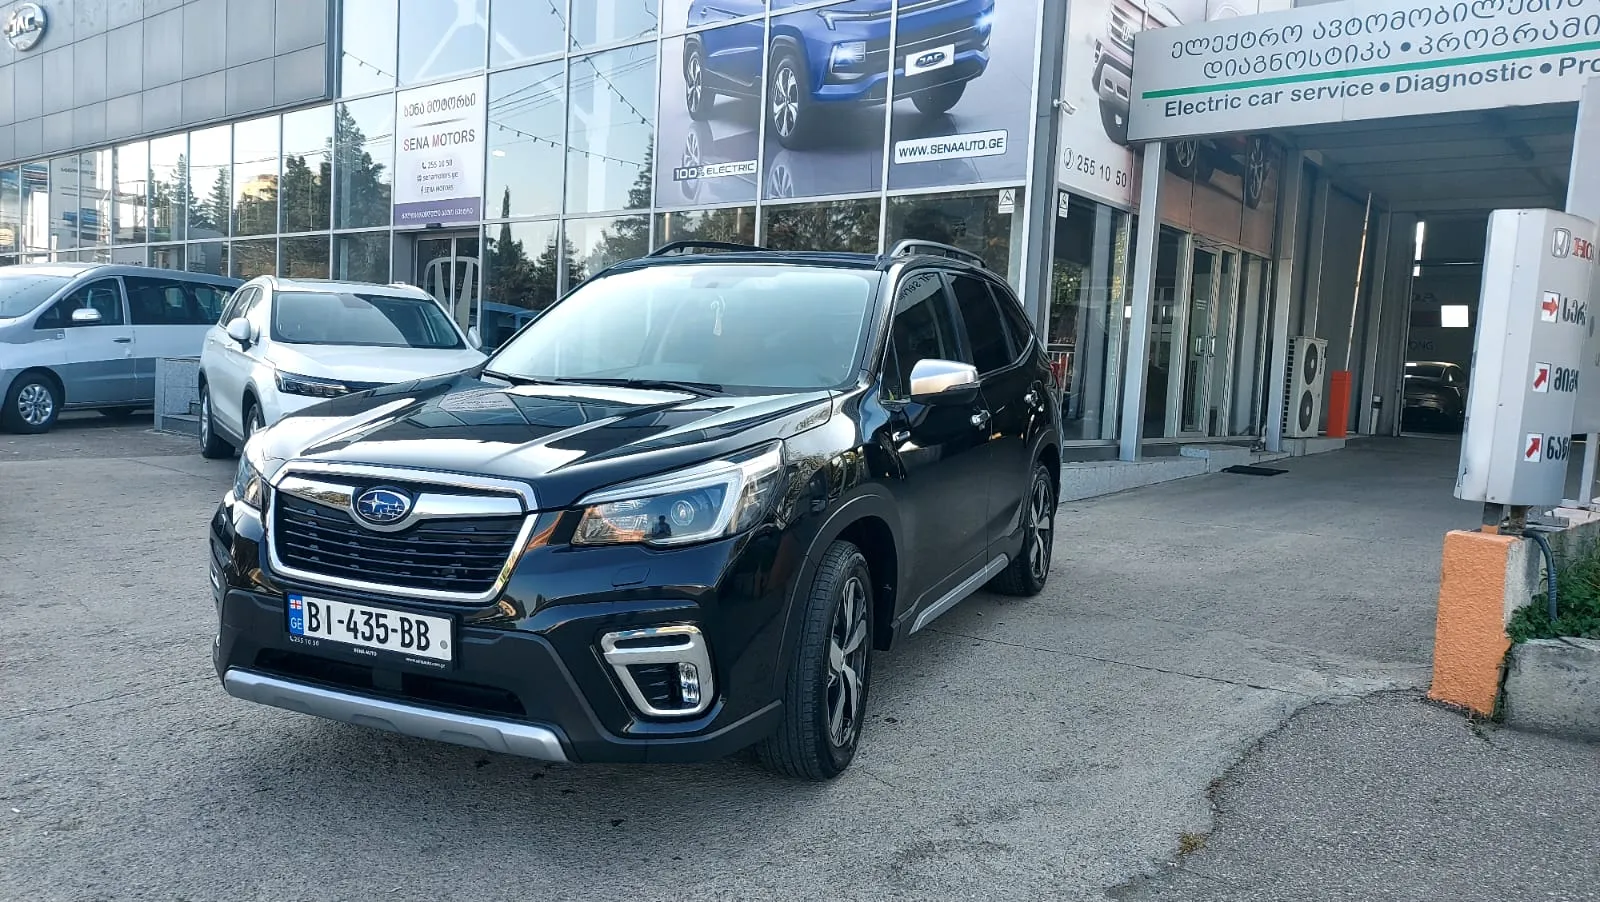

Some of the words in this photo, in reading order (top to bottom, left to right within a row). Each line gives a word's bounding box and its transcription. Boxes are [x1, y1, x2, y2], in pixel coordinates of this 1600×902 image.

[1171, 24, 1303, 59] ელექტრო
[1203, 40, 1391, 79] დიაგნოსტიკა
[1164, 93, 1242, 118] Electric
[1248, 90, 1283, 107] car
[1290, 80, 1374, 102] service
[1395, 62, 1533, 93] Diagnostic
[403, 102, 425, 118] სენა
[426, 92, 476, 114] მოტორსი
[403, 136, 430, 152] SENA
[431, 129, 476, 148] MOTORS
[899, 137, 1004, 158] WWW.SENAAUTO.GE
[706, 162, 755, 175] ELECTRIC
[1077, 154, 1096, 176] 255
[1100, 164, 1111, 182] 10
[1115, 170, 1127, 188] 50
[1572, 237, 1594, 262] HO
[1562, 297, 1587, 326] სერ
[290, 617, 303, 630] GE
[307, 602, 430, 651] BI-435-BB
